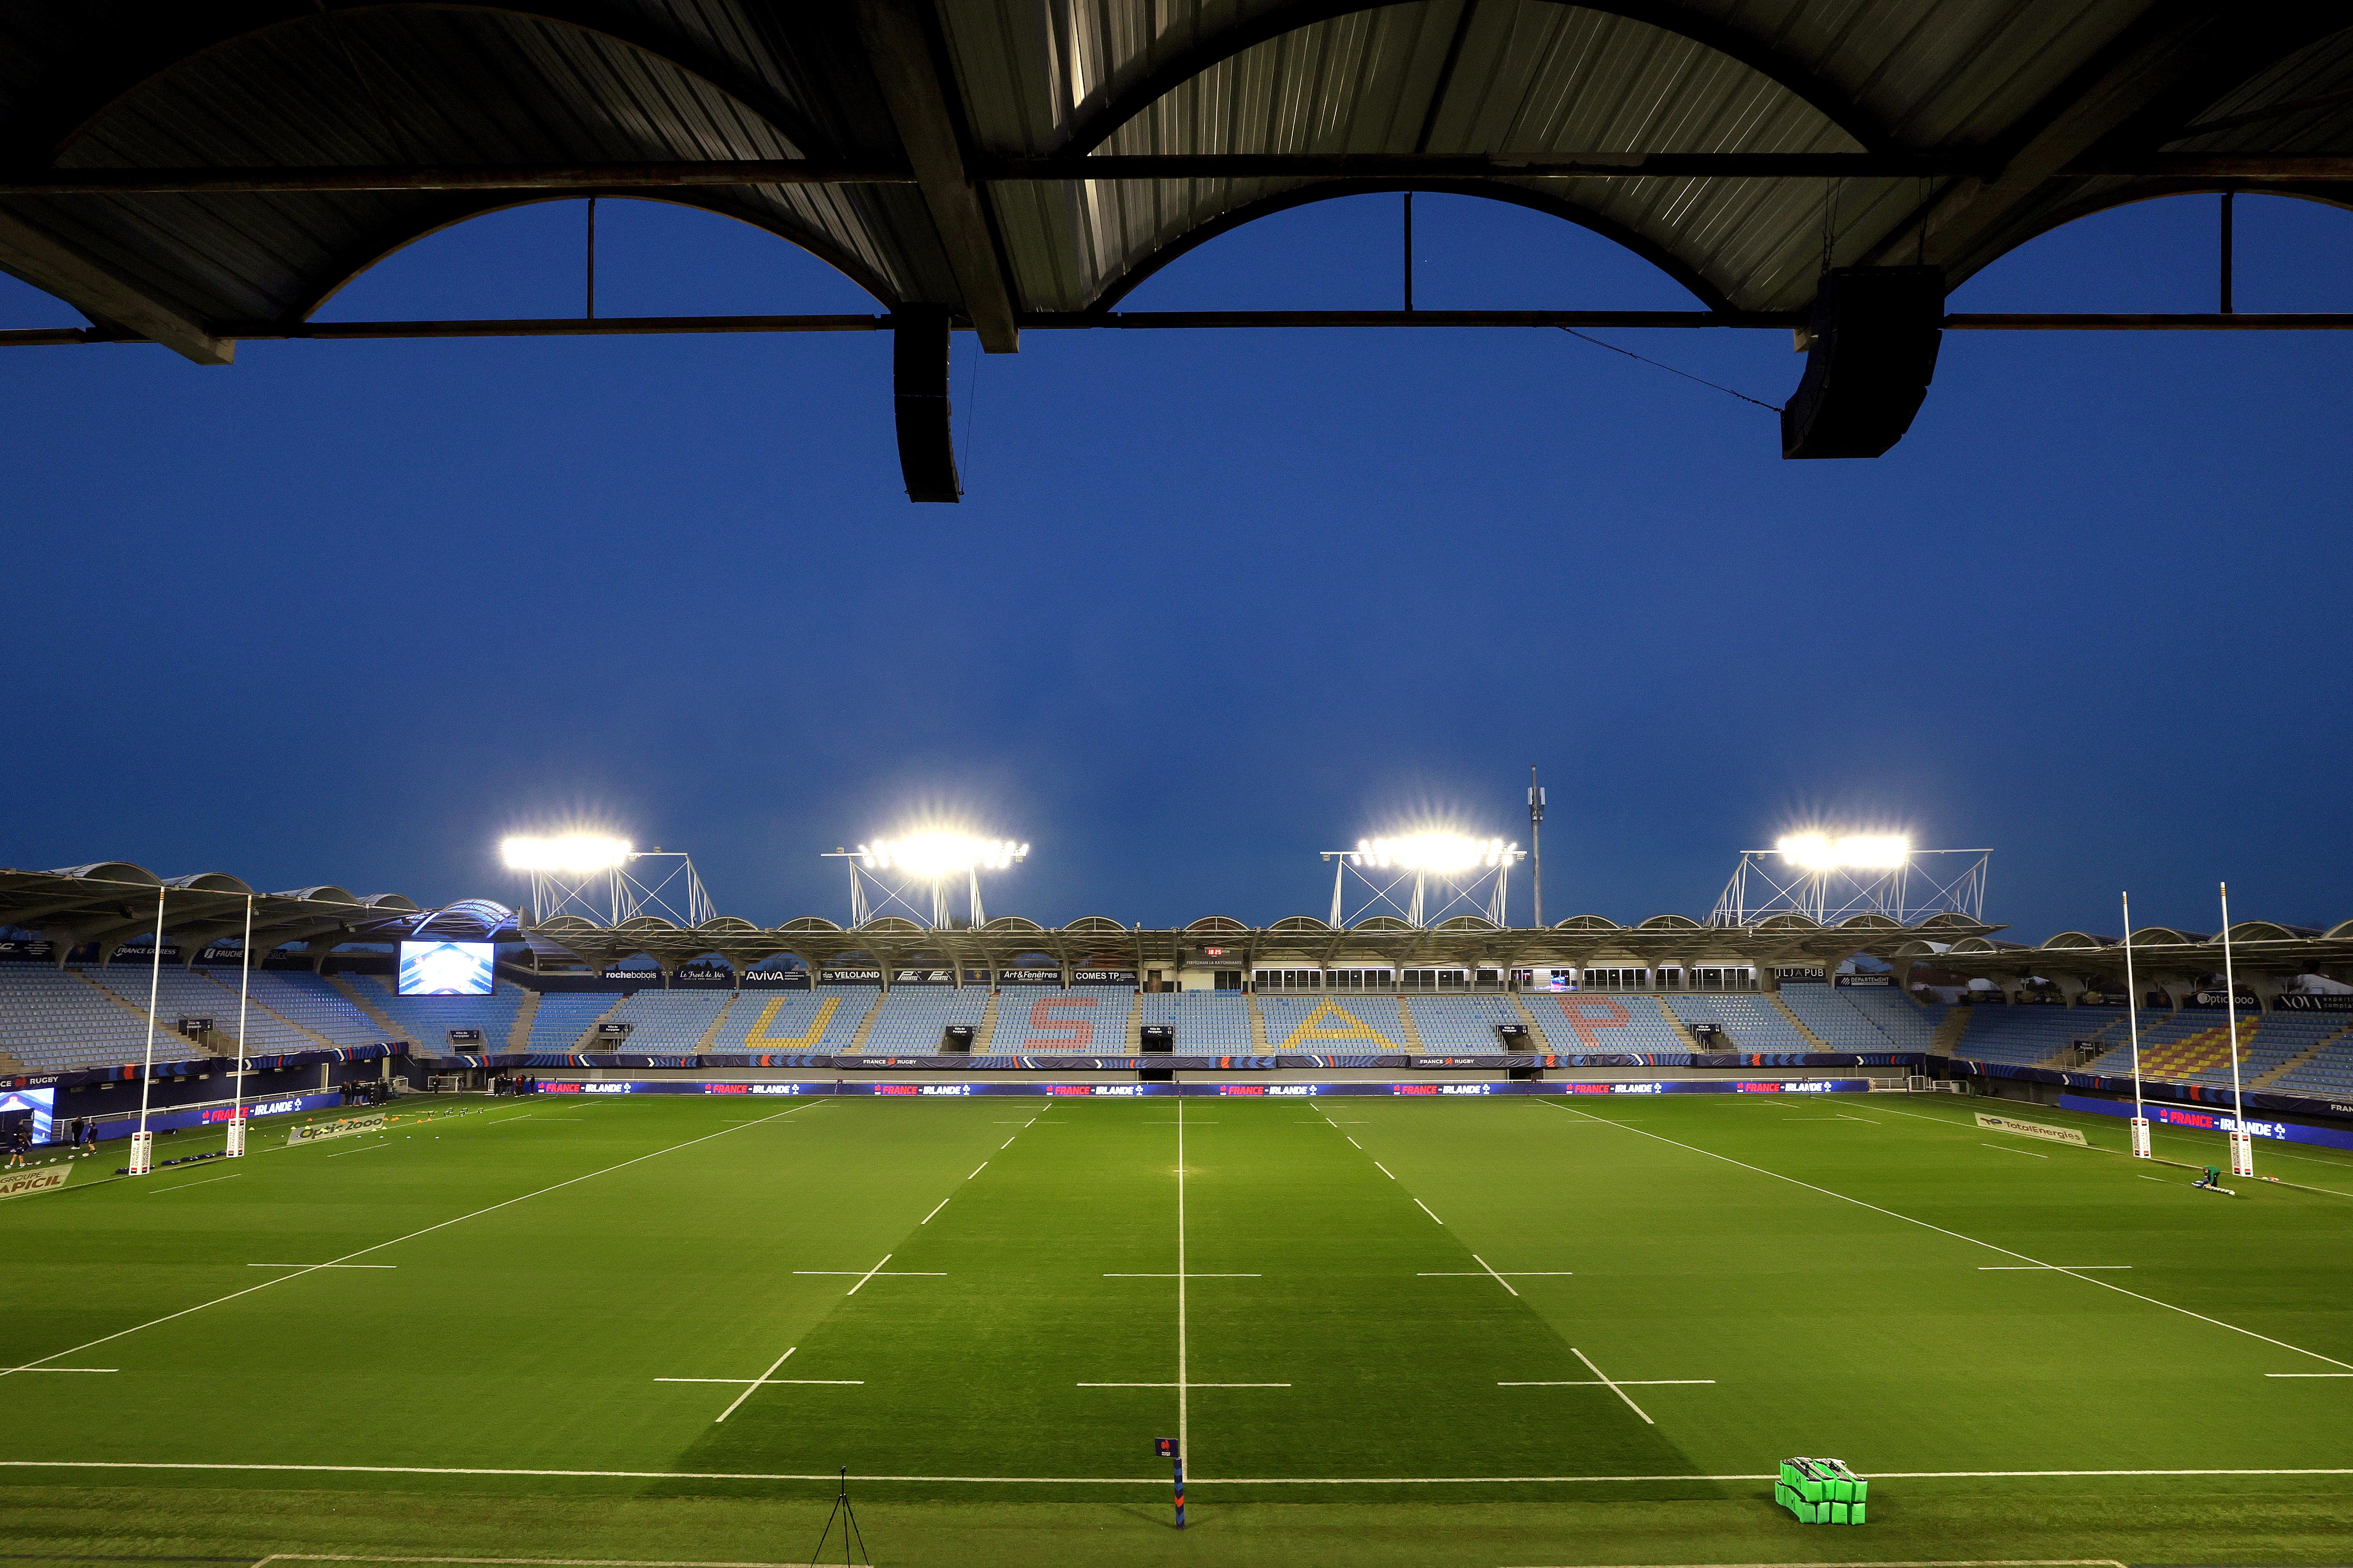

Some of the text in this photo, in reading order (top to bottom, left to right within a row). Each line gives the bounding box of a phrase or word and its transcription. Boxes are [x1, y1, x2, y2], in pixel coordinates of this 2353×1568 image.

[299, 1118, 383, 1139] Optic 2000
[2004, 1121, 2081, 1140] TotalEnergies
[0, 1171, 44, 1183] GROUPE
[0, 1175, 61, 1194] APICIL
